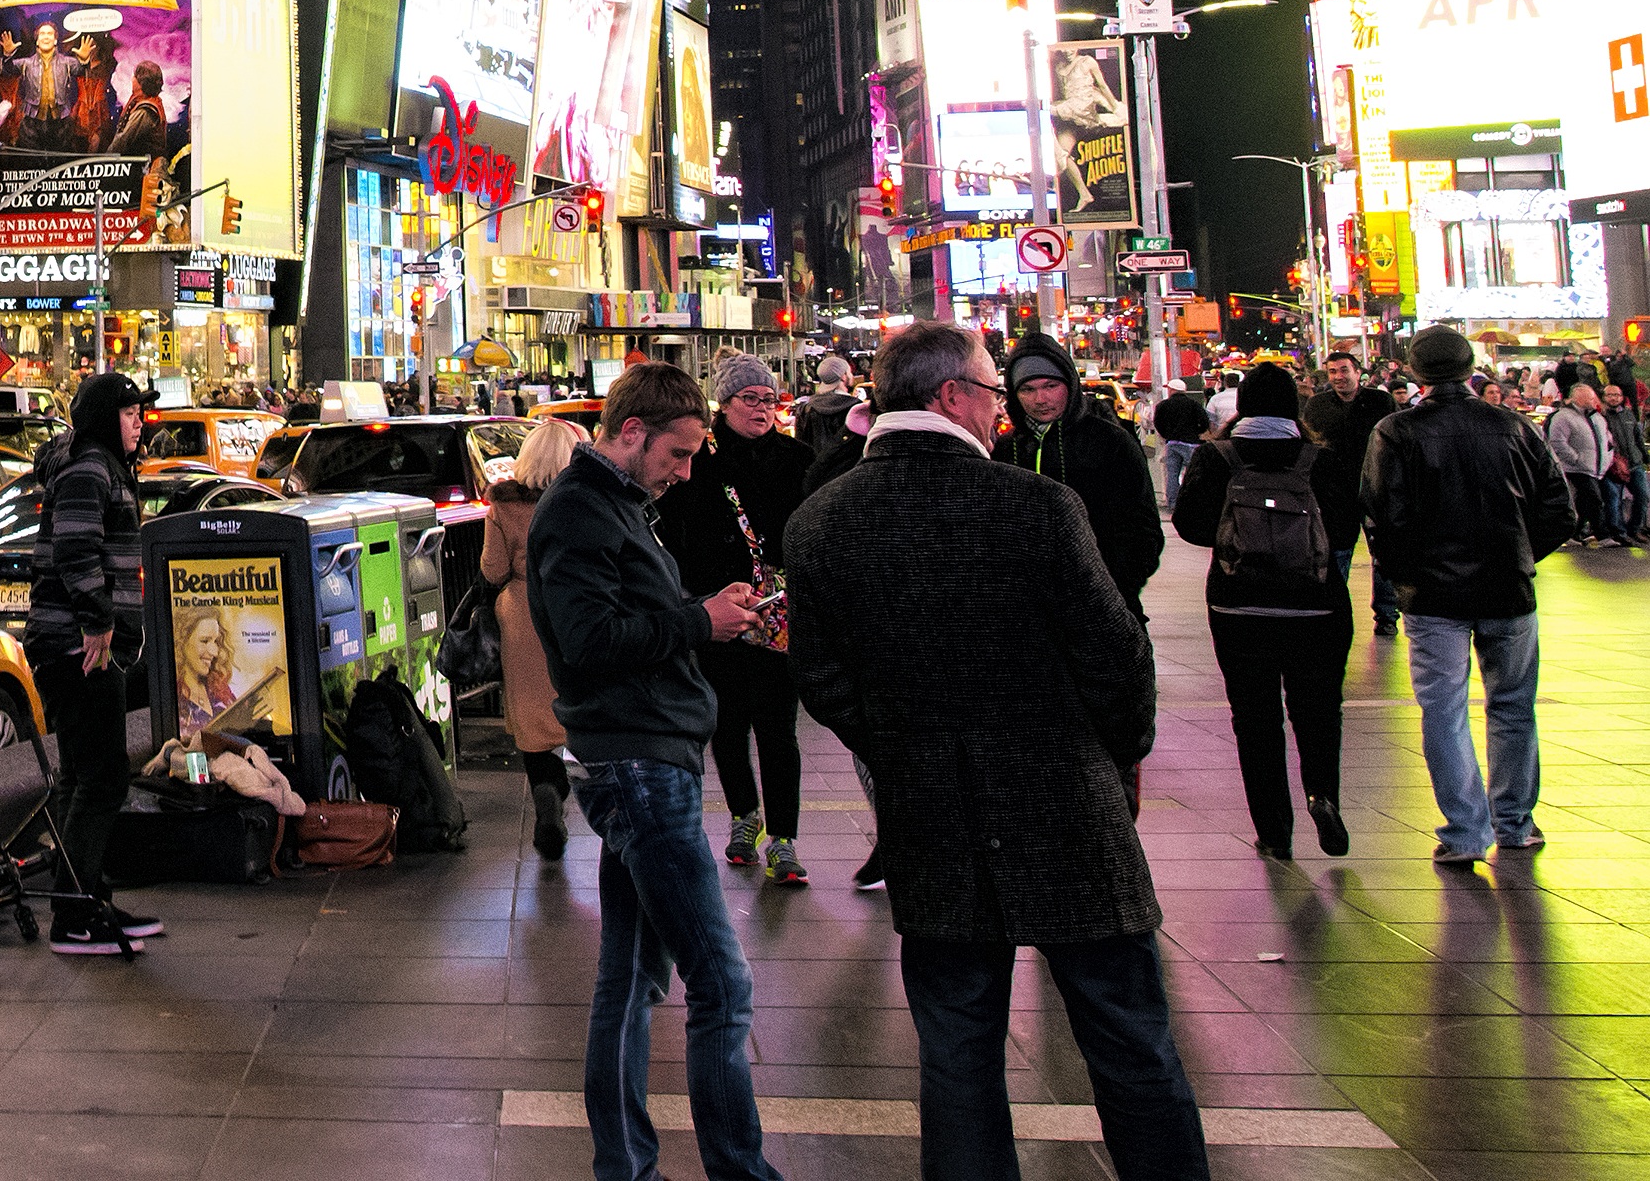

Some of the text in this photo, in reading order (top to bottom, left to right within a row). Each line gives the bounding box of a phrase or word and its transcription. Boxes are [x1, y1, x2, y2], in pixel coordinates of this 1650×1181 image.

[1076, 133, 1125, 166] SHUFFLE
[62, 163, 132, 179] ALADDIN
[1086, 154, 1126, 187] ALONG
[89, 179, 101, 189] OF
[37, 193, 57, 206] OF
[978, 209, 1028, 220] SONY
[11, 233, 44, 244] BTWN
[48, 232, 64, 243] 7TH
[66, 232, 75, 243] &
[77, 231, 93, 242] 8TH
[103, 231, 126, 241] VES
[1135, 239, 1144, 250] W
[1127, 256, 1182, 267] ONE WAY
[230, 255, 277, 282] LUGGAGE
[26, 298, 62, 310] BOWER
[161, 333, 171, 361] ATM
[200, 520, 242, 531] BigBelly
[171, 564, 278, 593] Beautiful
[174, 595, 279, 608] The Carole King Musical
